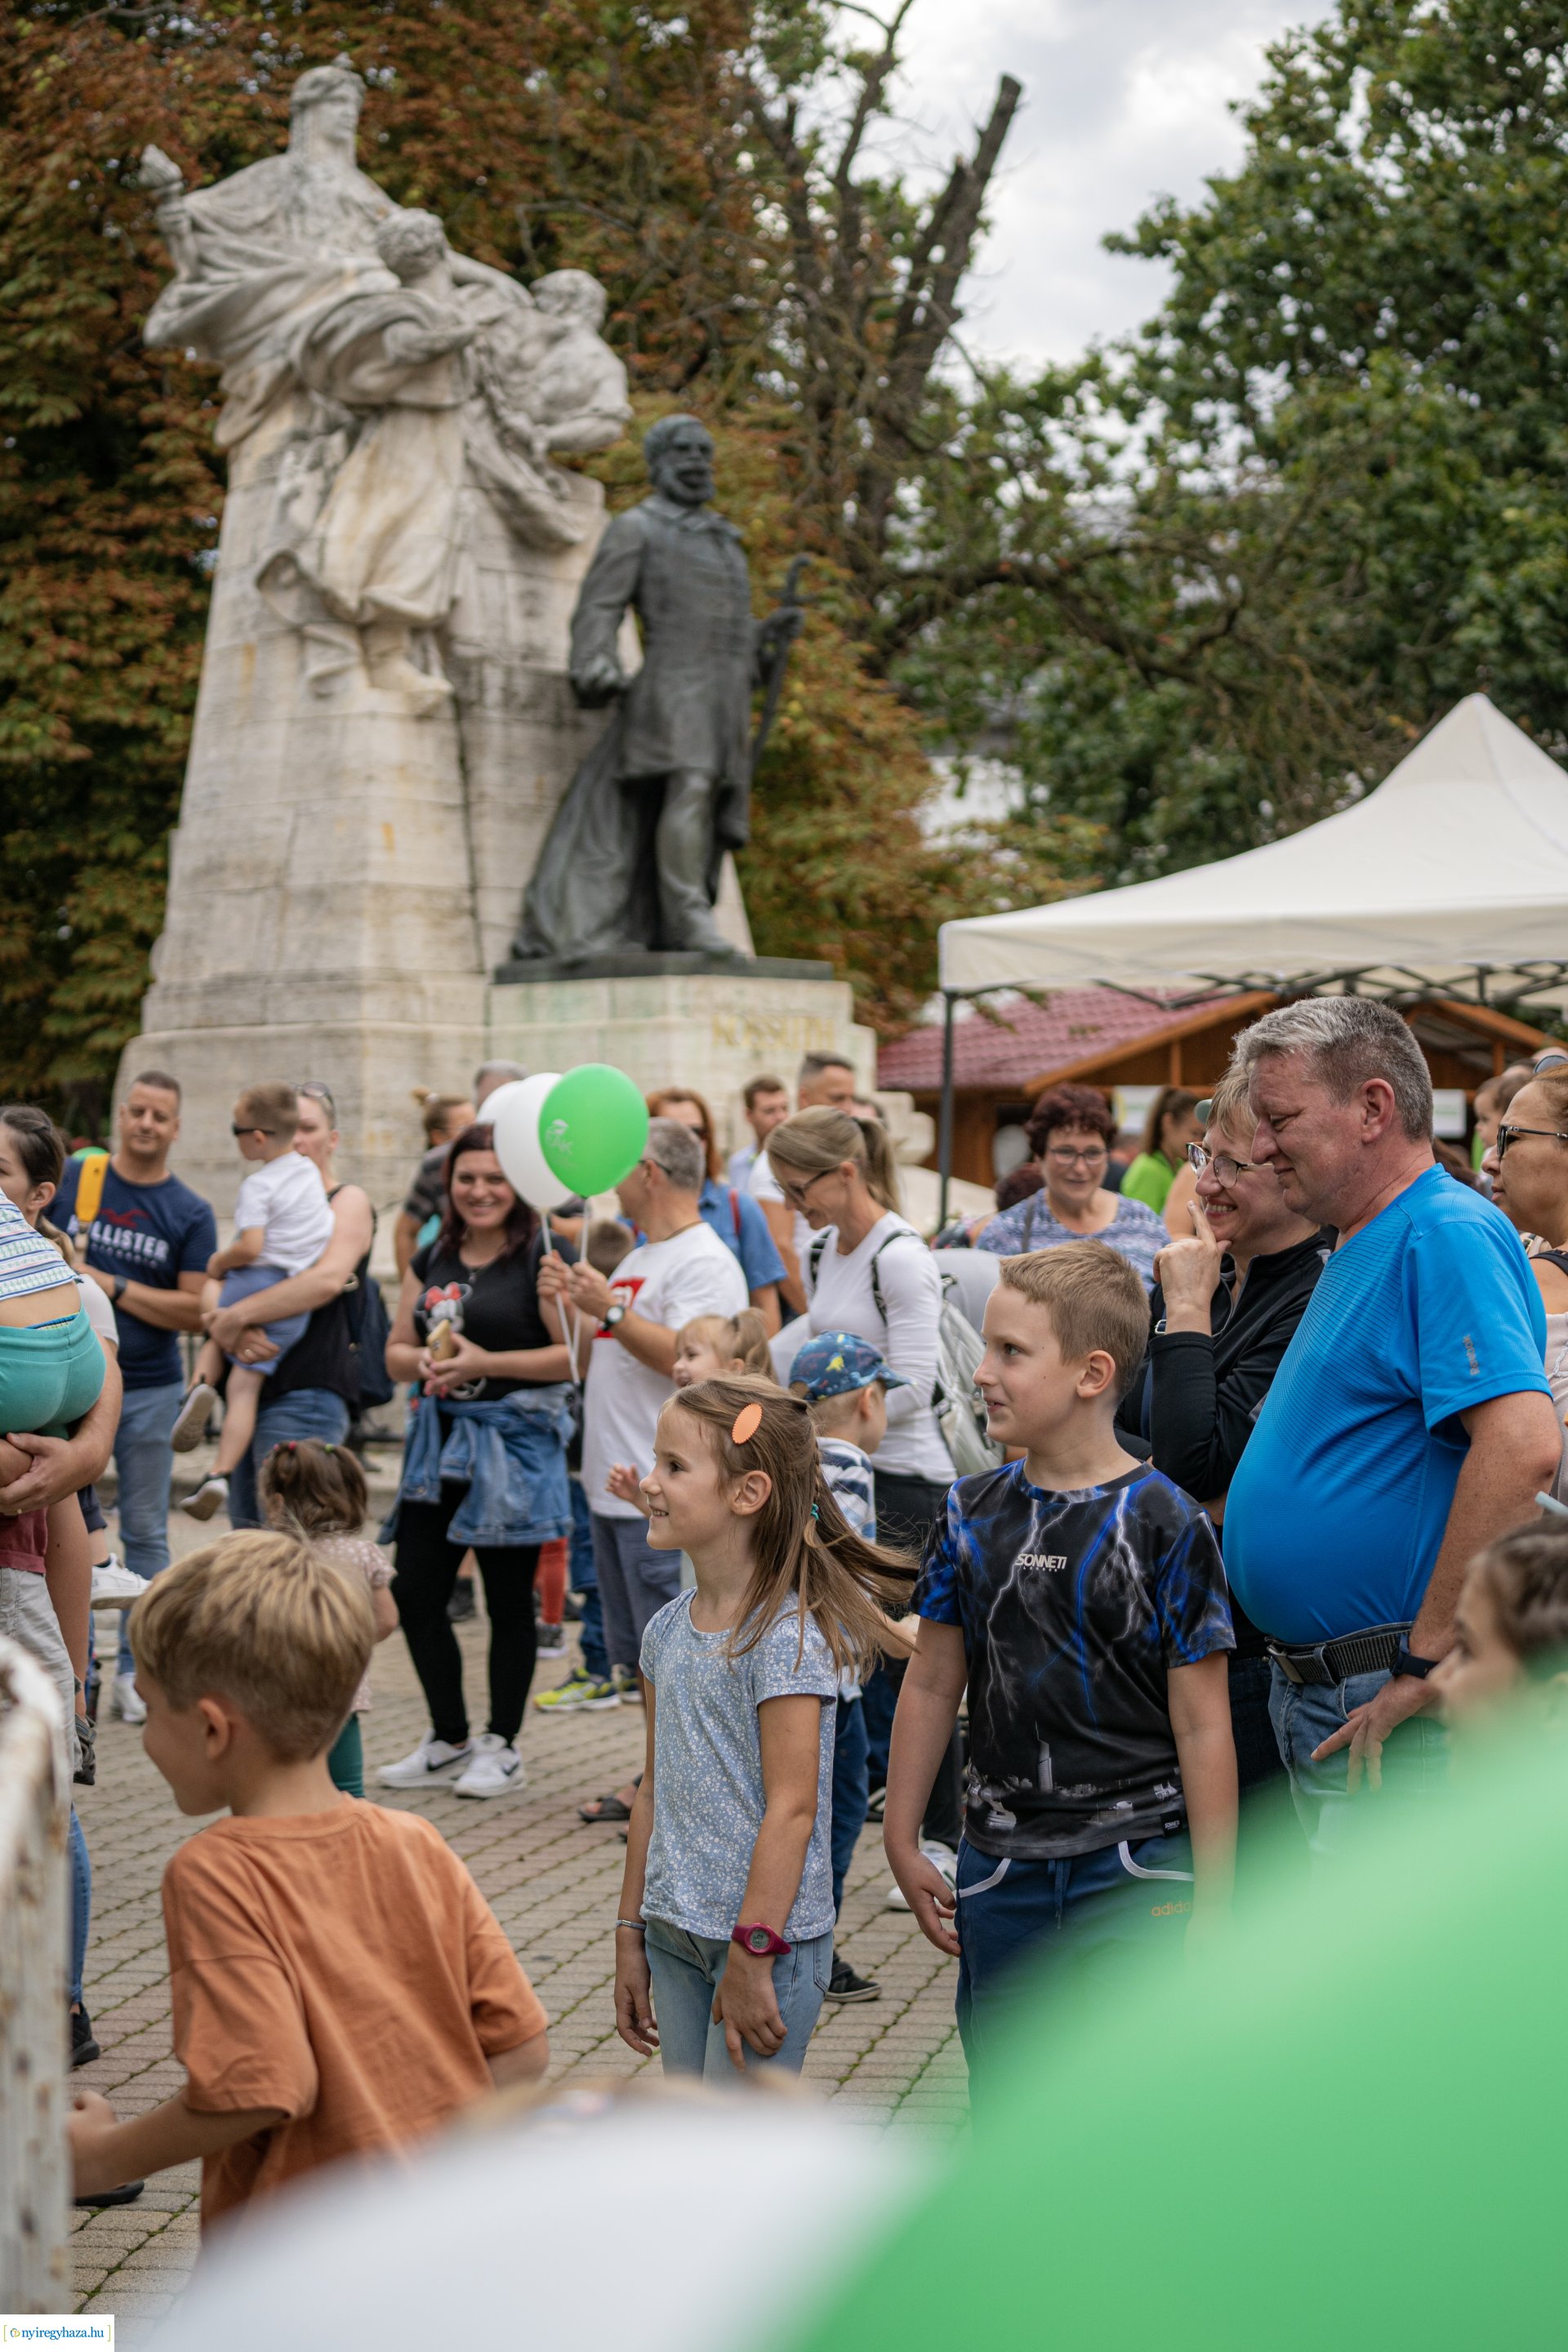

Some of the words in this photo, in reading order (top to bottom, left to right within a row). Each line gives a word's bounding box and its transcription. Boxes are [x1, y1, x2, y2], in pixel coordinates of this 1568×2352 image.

[65, 1214, 170, 1263] HLLISTER
[1015, 1553, 1067, 1570] SONNETI
[1151, 1900, 1192, 1917] adida
